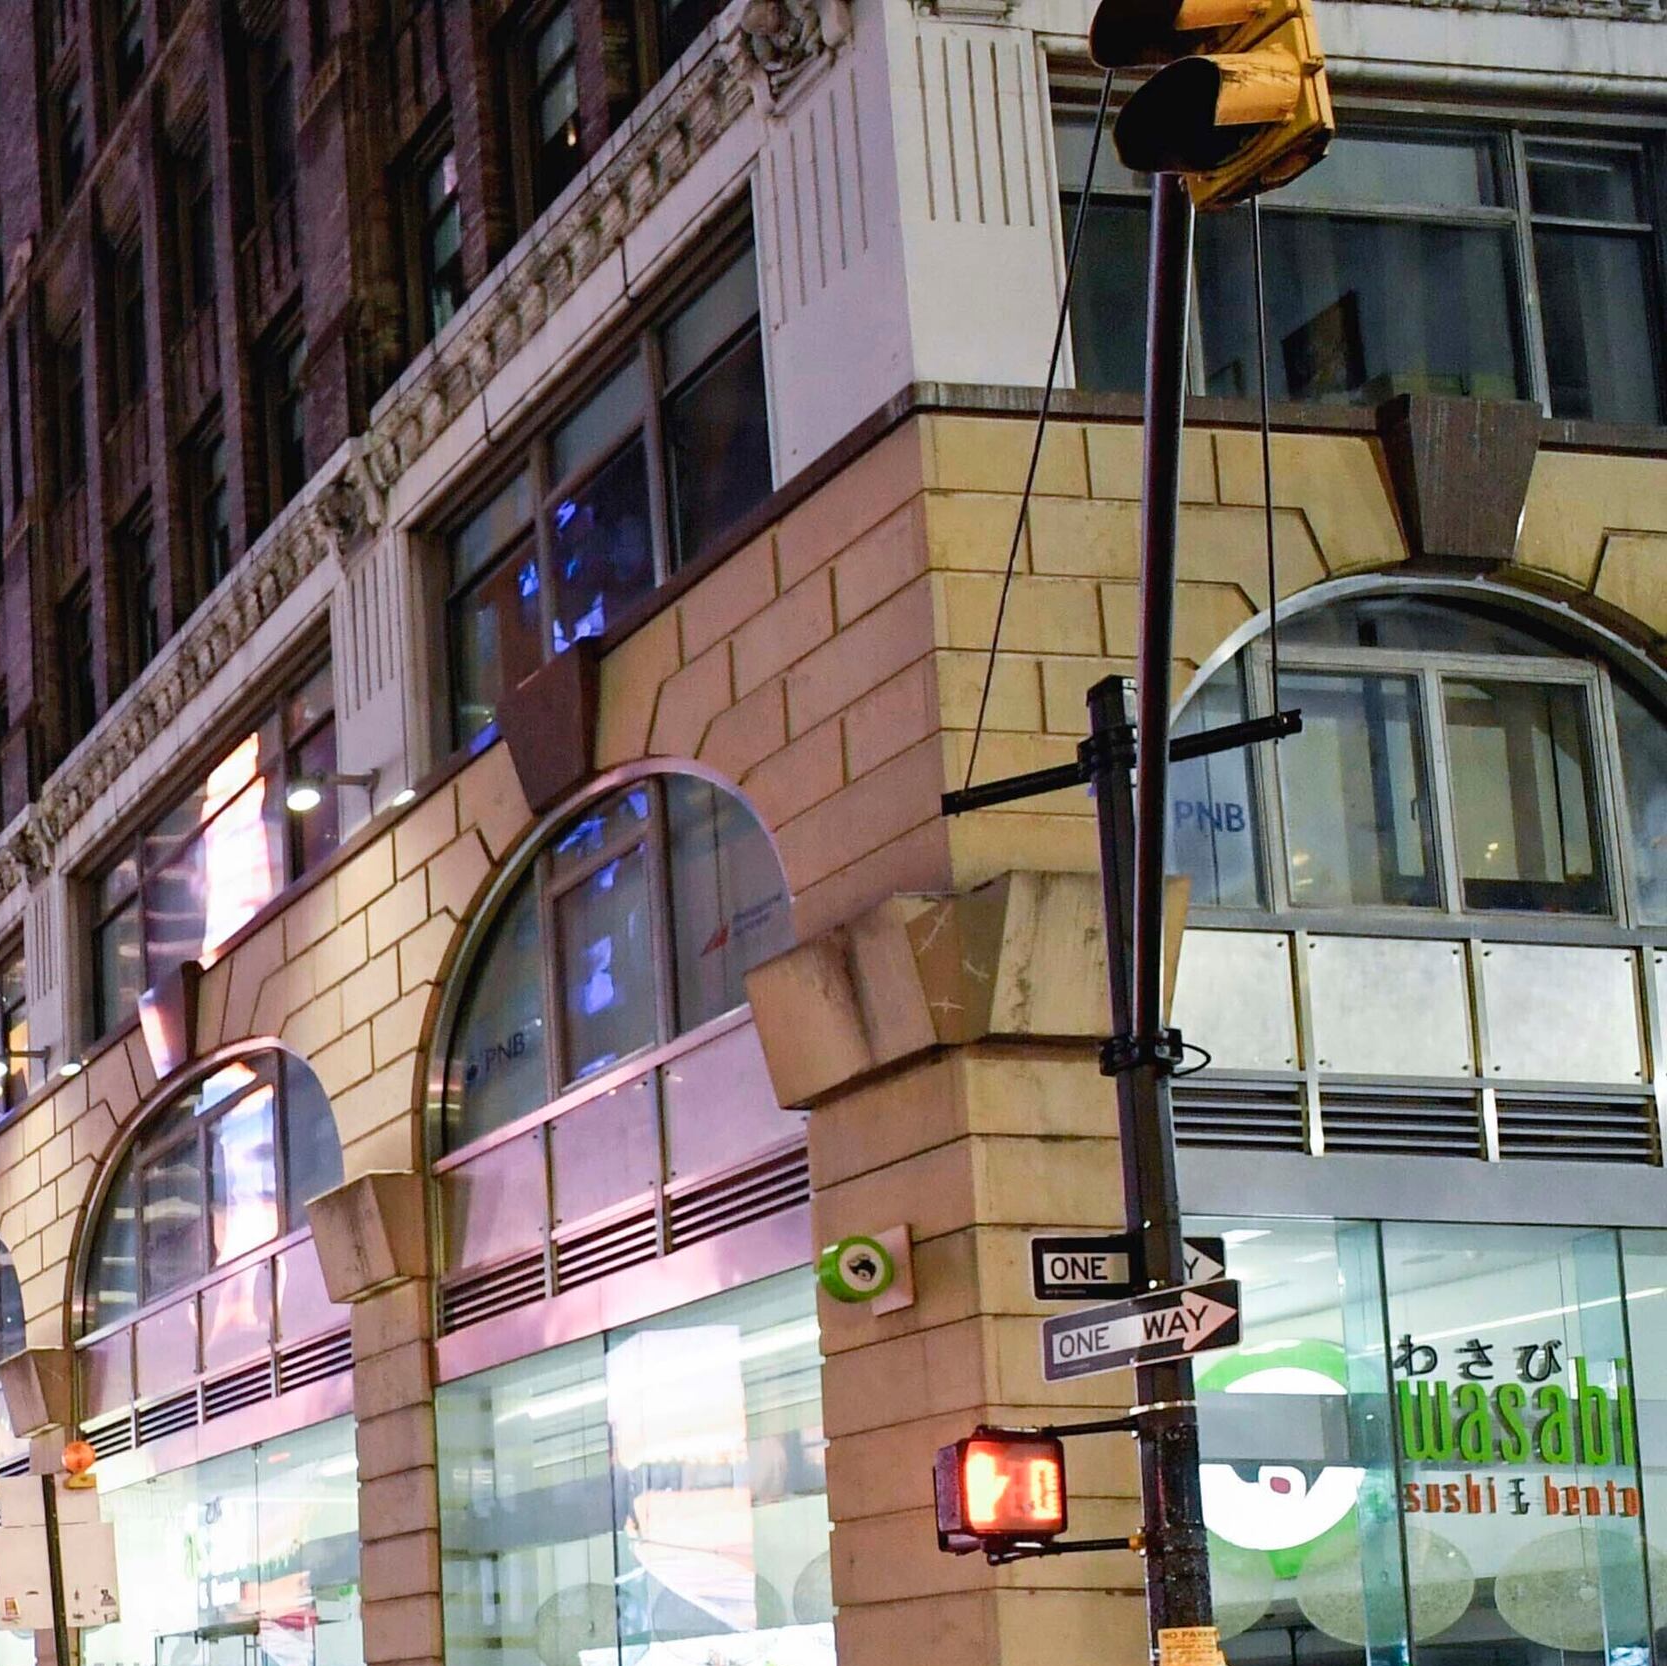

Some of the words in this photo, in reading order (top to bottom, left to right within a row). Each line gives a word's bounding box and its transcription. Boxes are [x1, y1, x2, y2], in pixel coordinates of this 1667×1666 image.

[1175, 800, 1245, 832] PNB
[1051, 1256, 1108, 1281] ONE
[1059, 1326, 1110, 1358] ONE
[1143, 1305, 1208, 1340] WAY
[1393, 1334, 1562, 1382] わさび
[1397, 1356, 1635, 1466] wasabi
[1403, 1473, 1497, 1514] sushi
[1544, 1474, 1640, 1517] bento
